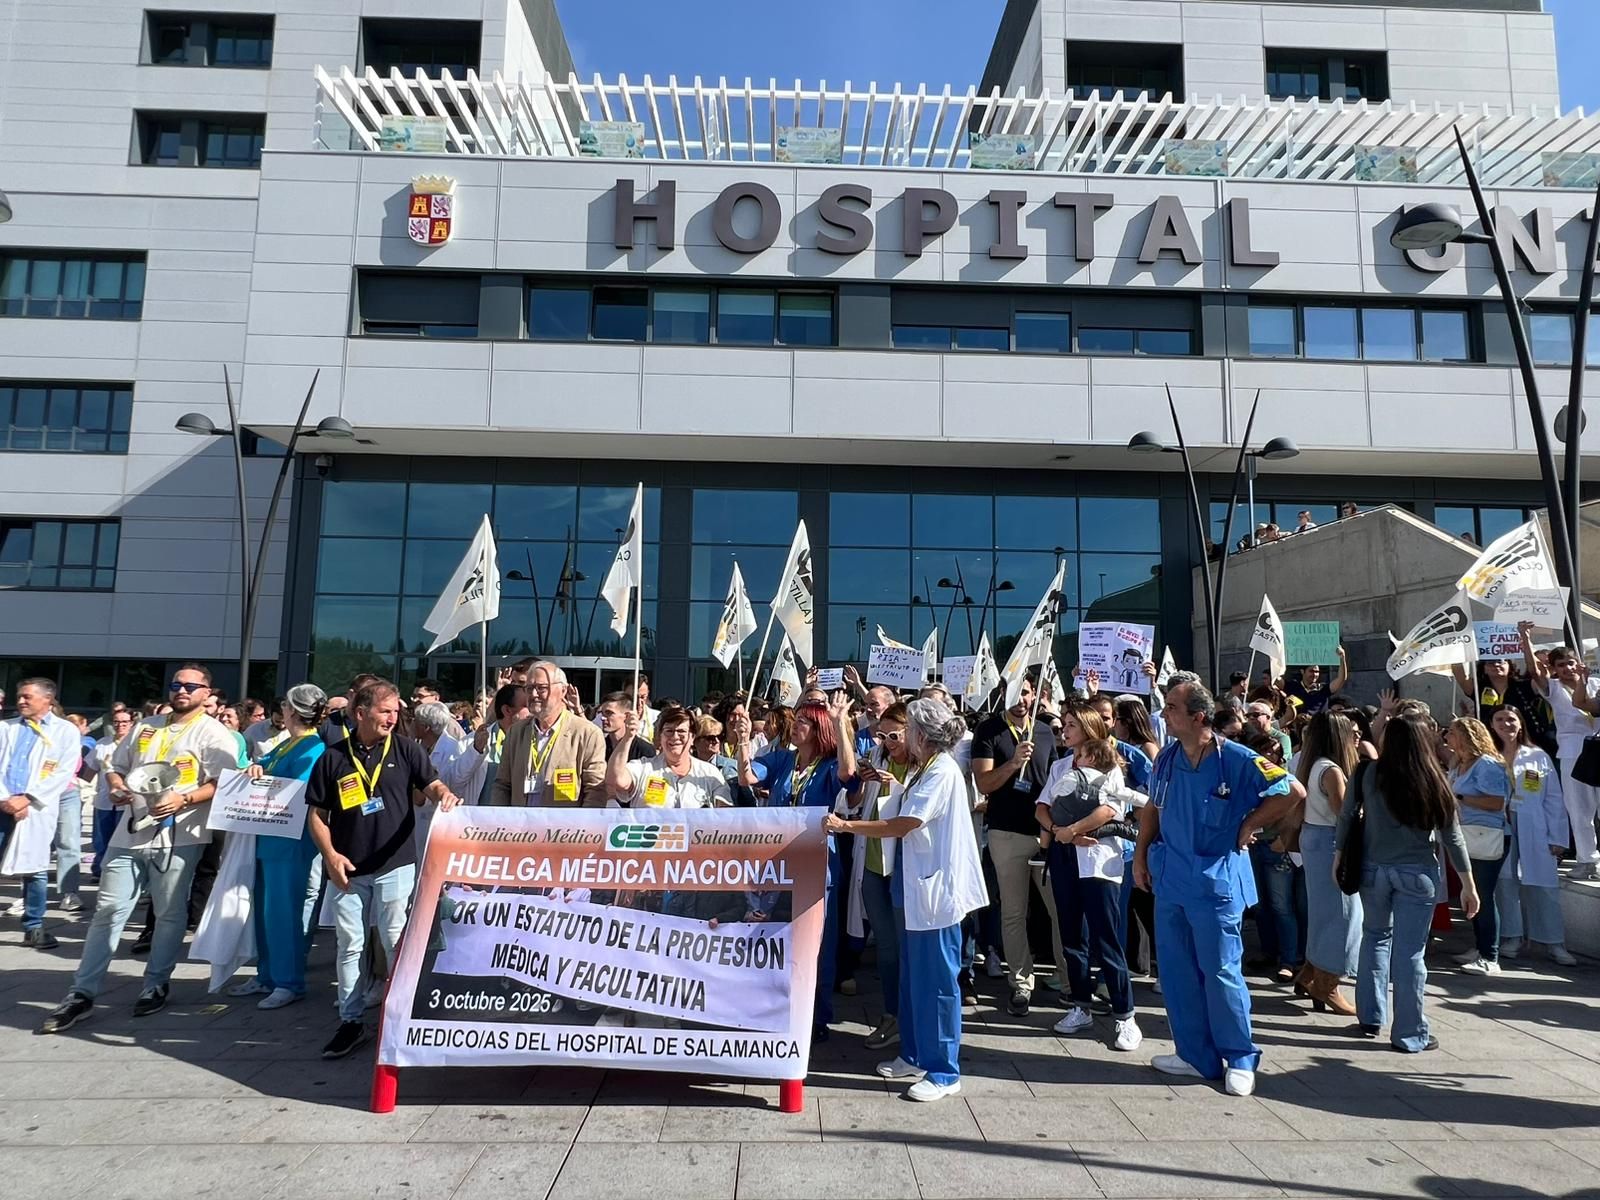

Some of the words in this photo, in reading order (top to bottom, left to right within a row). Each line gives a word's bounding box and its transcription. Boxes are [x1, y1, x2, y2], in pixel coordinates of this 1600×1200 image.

[614, 178, 1280, 268] HOSPITAL
[876, 653, 900, 662] RISA
[459, 826, 538, 843] Sindicato
[542, 828, 603, 844] Médico
[609, 824, 685, 849] CESM
[691, 829, 784, 845] Salamanca
[445, 852, 553, 882] HUELGA
[559, 852, 657, 884] MÉDICA
[663, 858, 794, 885] NACIONAL
[450, 900, 480, 925] OR
[483, 901, 512, 928] UN
[514, 903, 604, 944] ESTATUTO
[606, 918, 635, 950] DE
[634, 924, 660, 956] LA
[665, 929, 784, 970] PROFESIÓN
[491, 938, 550, 982] MÉDICA
[554, 956, 572, 985] Y
[569, 960, 706, 1012] FACULTATIVA
[429, 988, 441, 1009] 3
[444, 991, 506, 1011] octubre
[509, 992, 552, 1013] 2025
[406, 1027, 510, 1050] MEDICO/AS
[515, 1032, 551, 1051] DEL
[556, 1033, 648, 1055] HOSPITAL
[653, 1037, 678, 1056] DE
[683, 1038, 801, 1059] SALAMANCA
